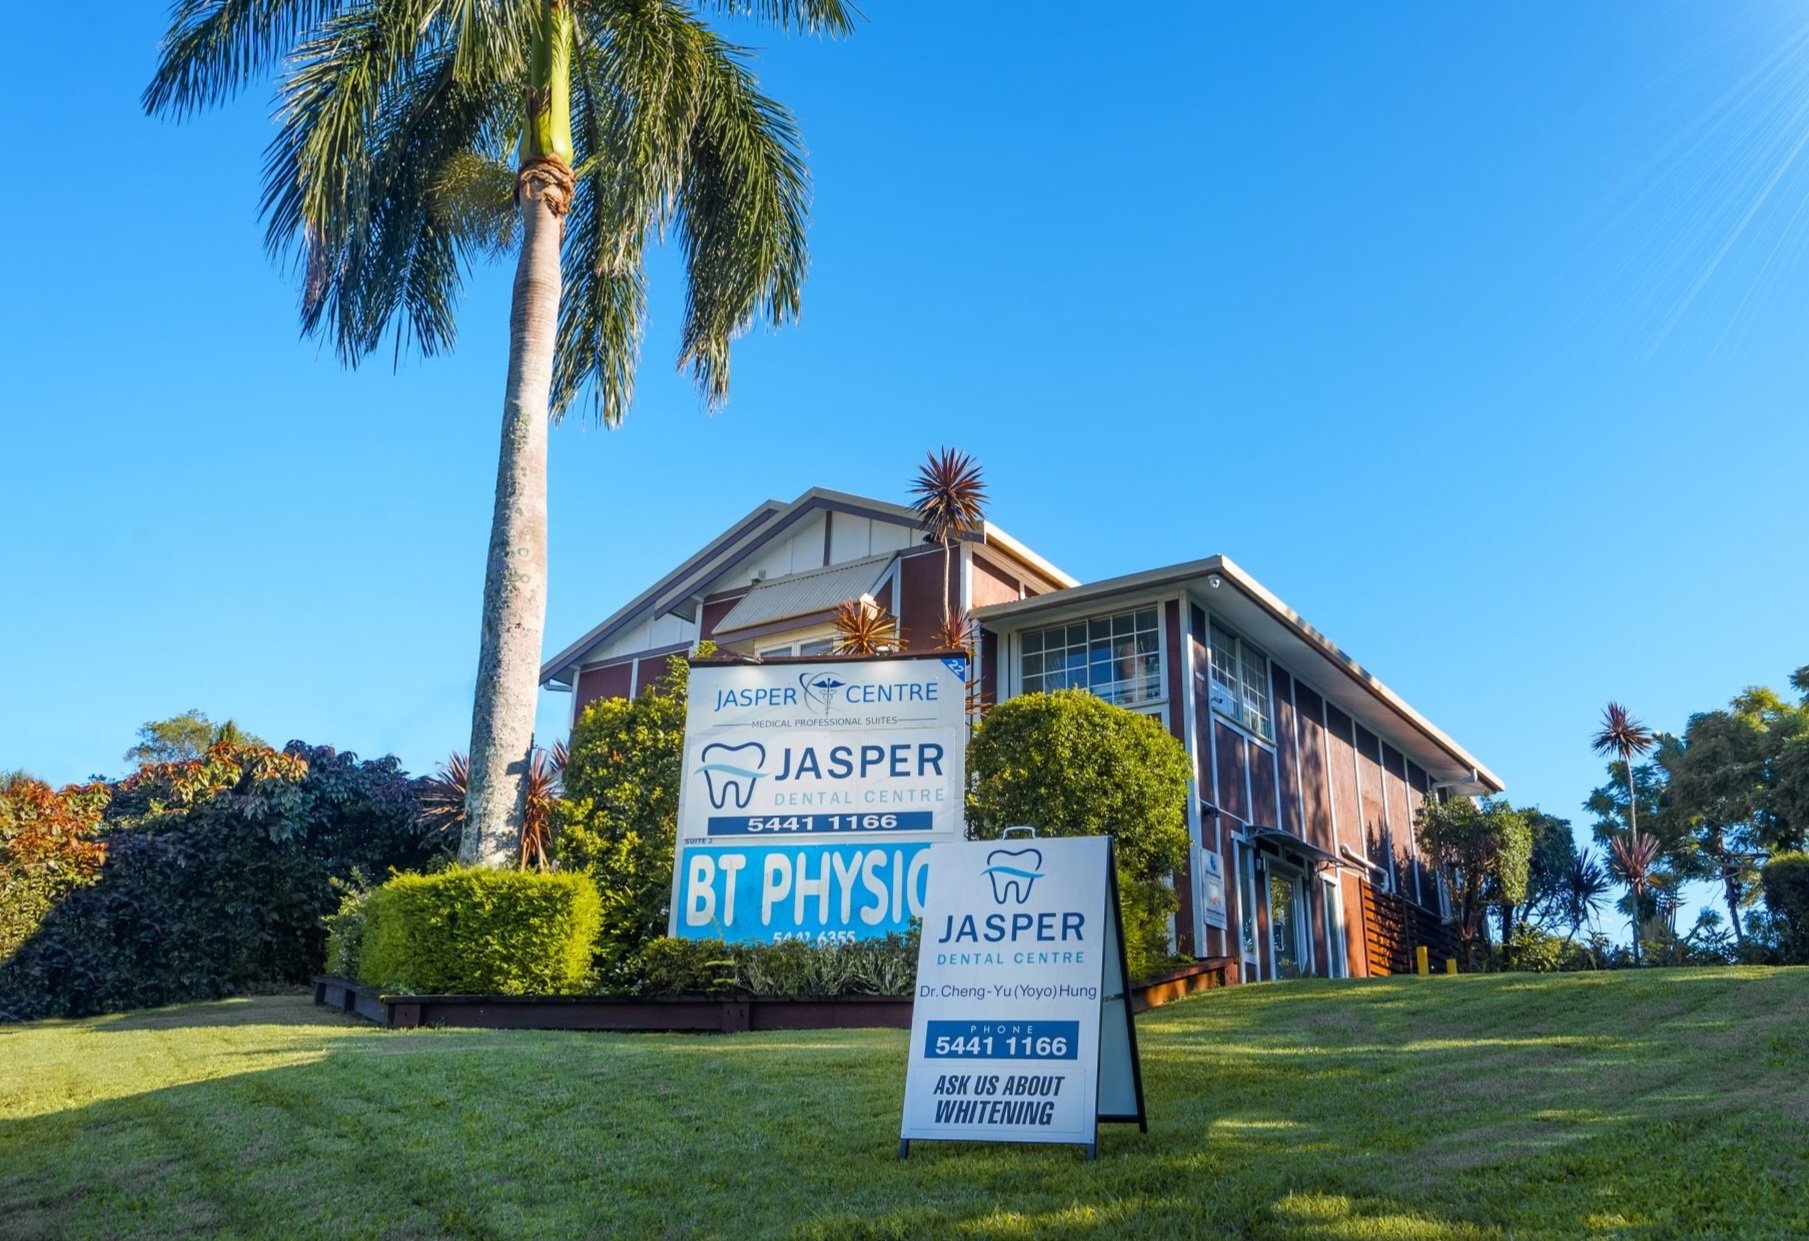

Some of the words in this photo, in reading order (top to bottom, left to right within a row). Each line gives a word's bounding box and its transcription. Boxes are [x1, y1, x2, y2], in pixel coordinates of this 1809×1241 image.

[948, 659, 964, 676] 22
[714, 688, 797, 712] JASPER
[846, 682, 938, 703] CENTRE
[752, 719, 792, 728] MEDICAL
[794, 717, 863, 728] PROFESSIONAL
[865, 716, 898, 725] SUITES
[775, 743, 944, 781] JASPER
[774, 791, 852, 806] DENTAL
[864, 788, 944, 803] CENTRE
[747, 817, 815, 832] 5441
[828, 815, 898, 830] 1166
[686, 854, 746, 927] BT
[938, 912, 1085, 944] JASPER
[937, 953, 1004, 965] DENTAL
[1014, 952, 1084, 964] CENTRE
[920, 985, 939, 998] Dr.
[1014, 985, 1057, 1000] (Yoyo)
[1059, 985, 1097, 1000] Hung
[970, 1025, 1033, 1034] PHONE
[935, 1036, 993, 1055] 5441
[1006, 1037, 1067, 1055] 1166
[933, 1075, 971, 1095] ASK
[974, 1075, 999, 1095] US
[1002, 1075, 1065, 1096] ABOUT
[934, 1100, 1054, 1126] WHITENING
